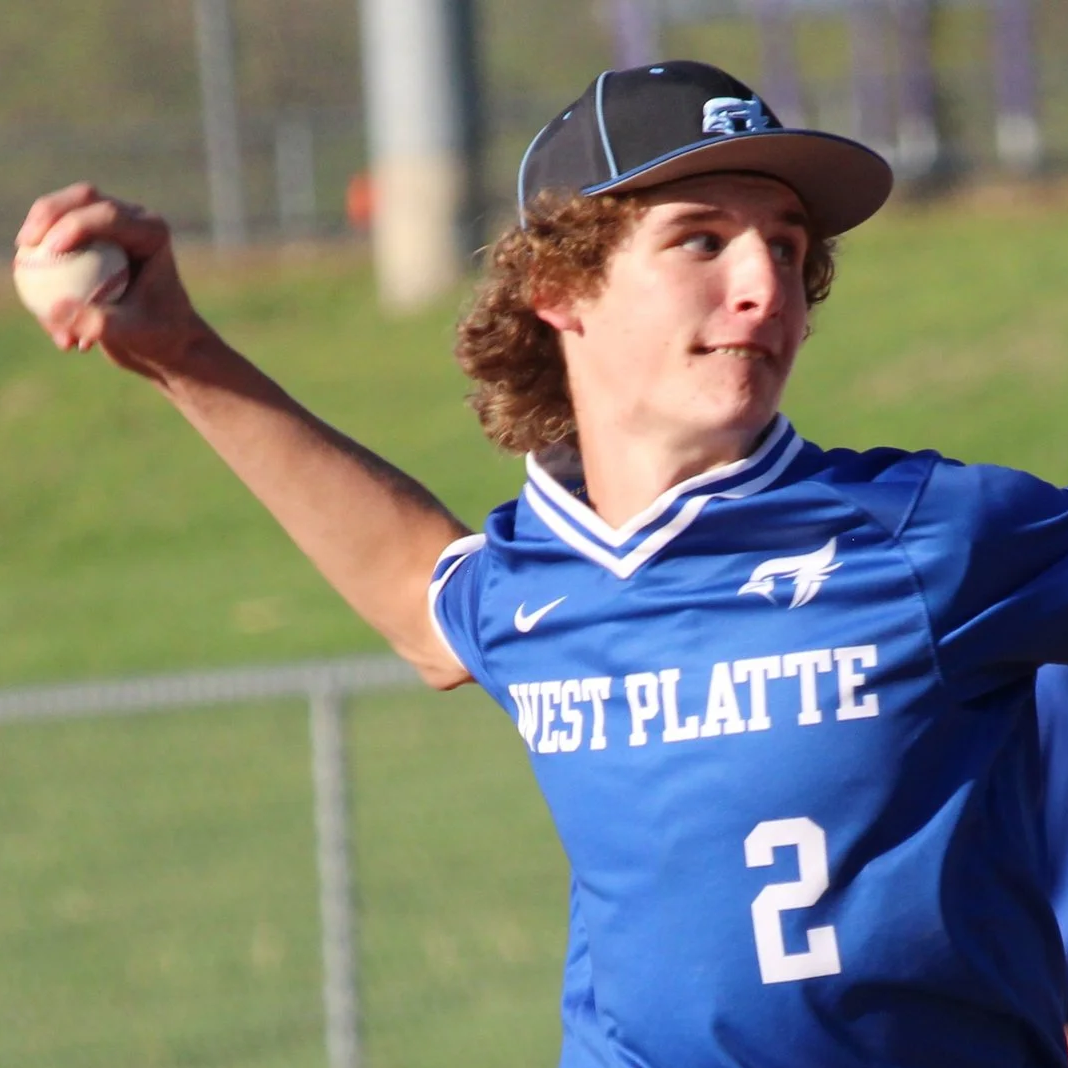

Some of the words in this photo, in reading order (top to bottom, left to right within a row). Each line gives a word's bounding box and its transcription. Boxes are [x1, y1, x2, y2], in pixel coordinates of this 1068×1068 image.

[508, 675, 612, 755] WEST
[624, 643, 880, 747] PLATTE
[743, 815, 842, 986] 2
